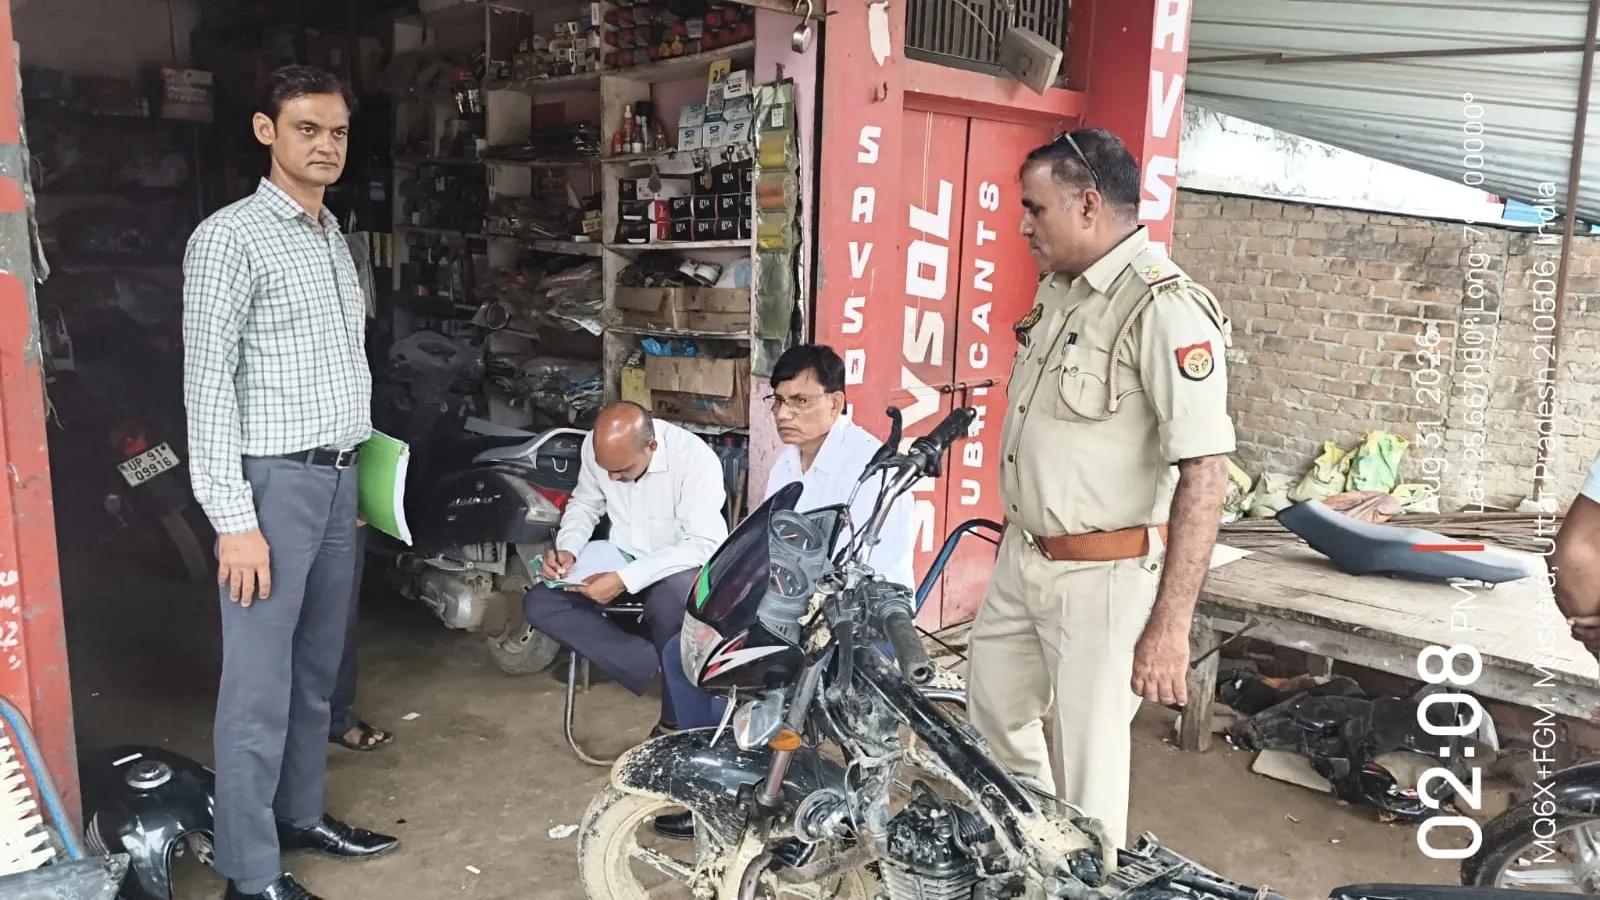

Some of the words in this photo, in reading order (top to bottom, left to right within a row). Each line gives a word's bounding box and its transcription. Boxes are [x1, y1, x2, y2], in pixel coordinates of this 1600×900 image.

[841, 125, 882, 421] SAVSO
[1139, 0, 1192, 259] AVS
[128, 457, 142, 471] UP
[147, 448, 163, 461] 91
[899, 179, 953, 553] SVSOL
[960, 180, 1000, 536] UBRICANTS
